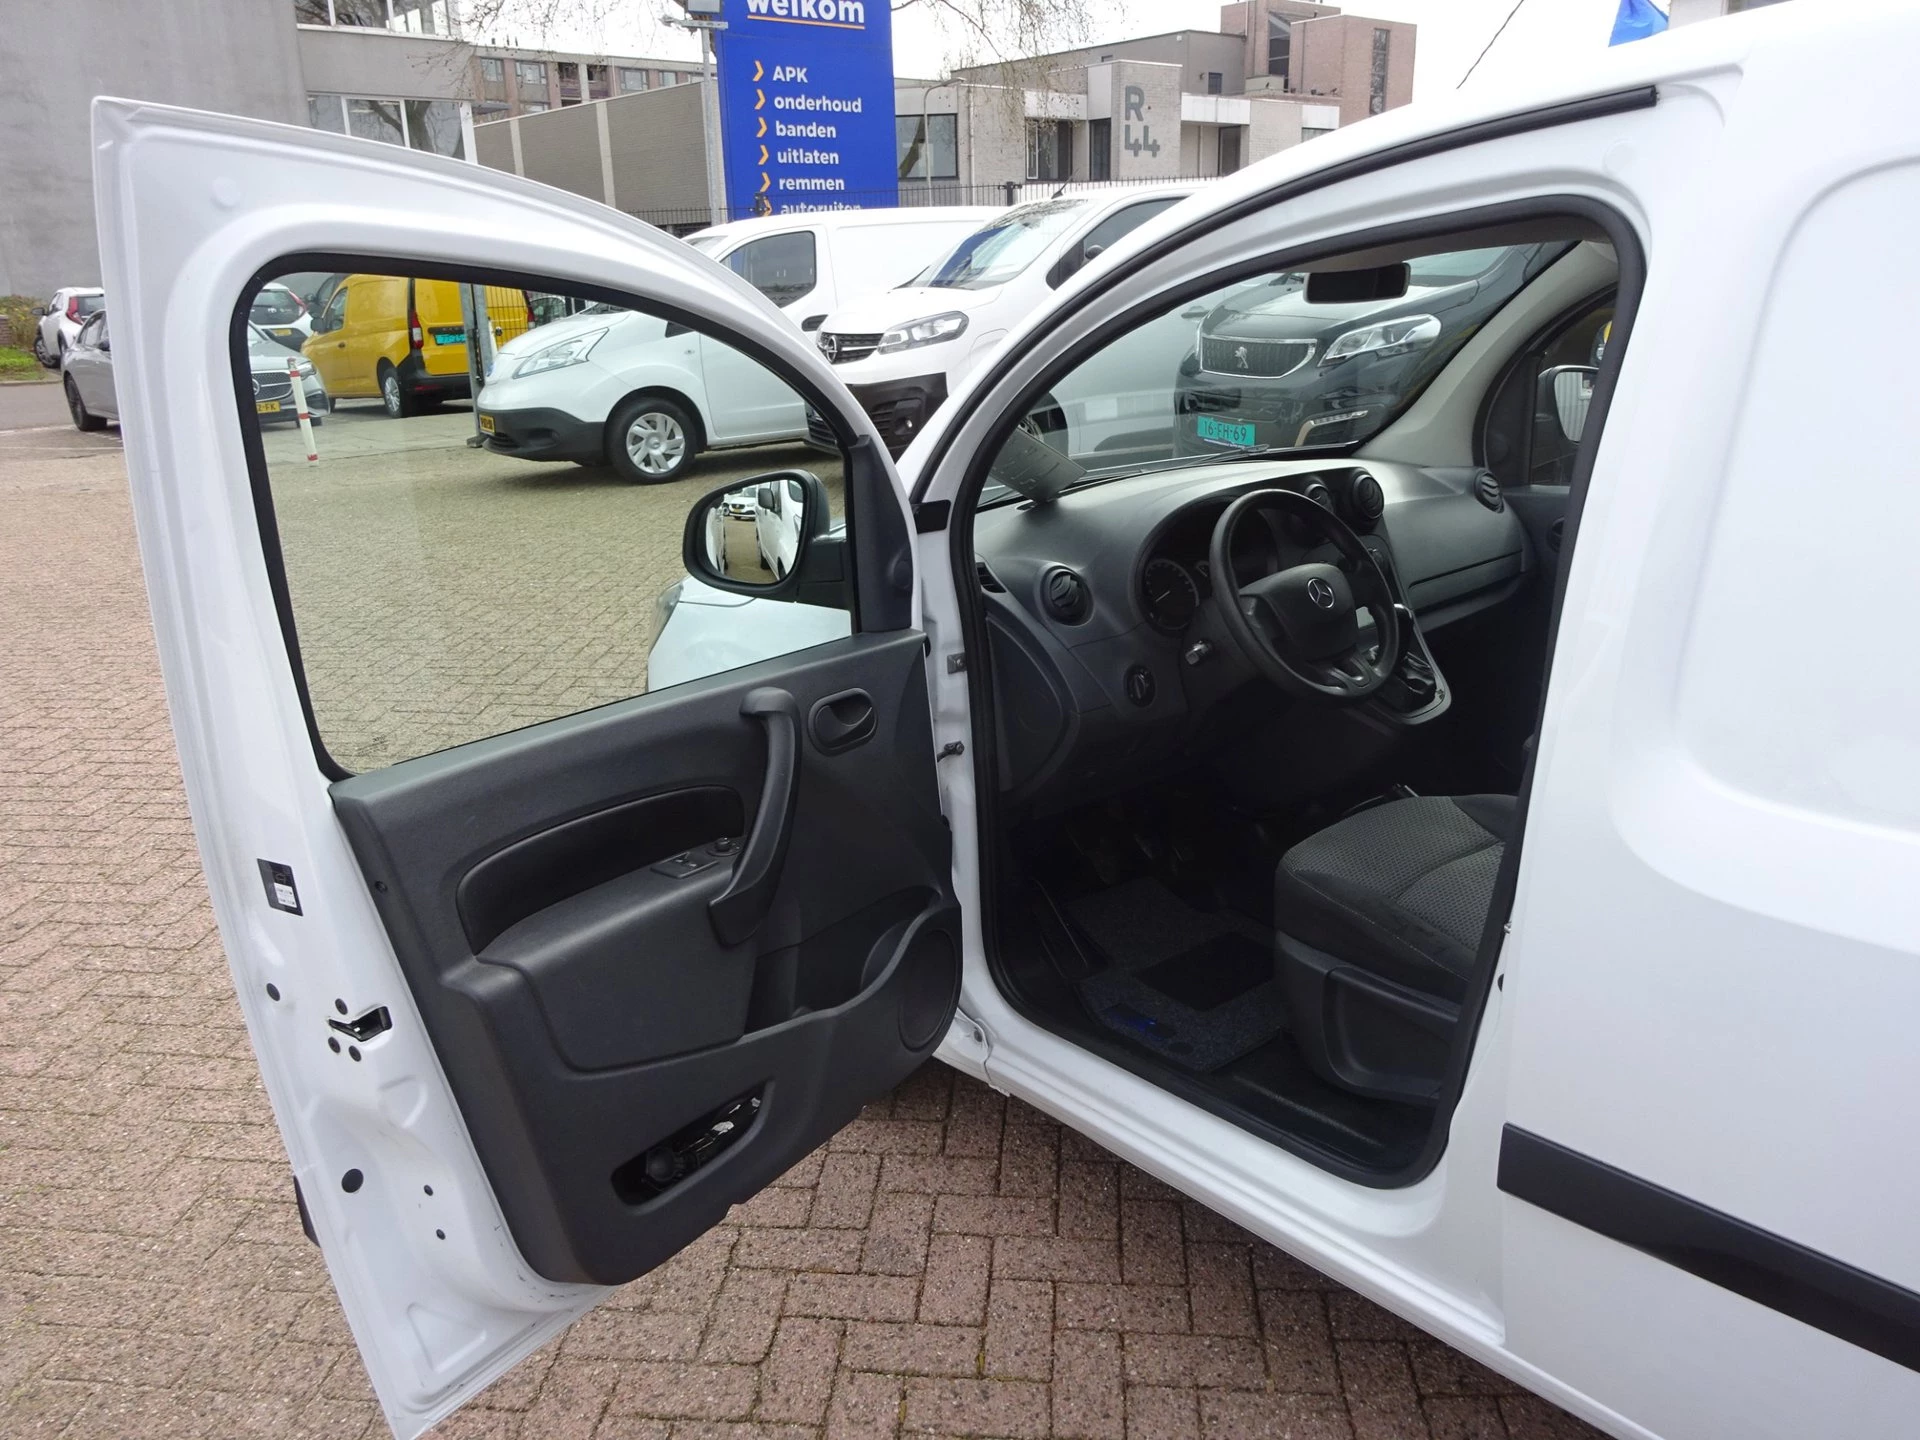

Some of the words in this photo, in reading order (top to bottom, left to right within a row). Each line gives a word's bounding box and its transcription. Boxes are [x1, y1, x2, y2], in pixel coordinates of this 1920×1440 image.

[772, 65, 809, 84] APK
[774, 95, 862, 113] onderhoud
[775, 120, 837, 138] banden
[777, 148, 839, 165] uitlaten
[778, 177, 845, 191] remmen
